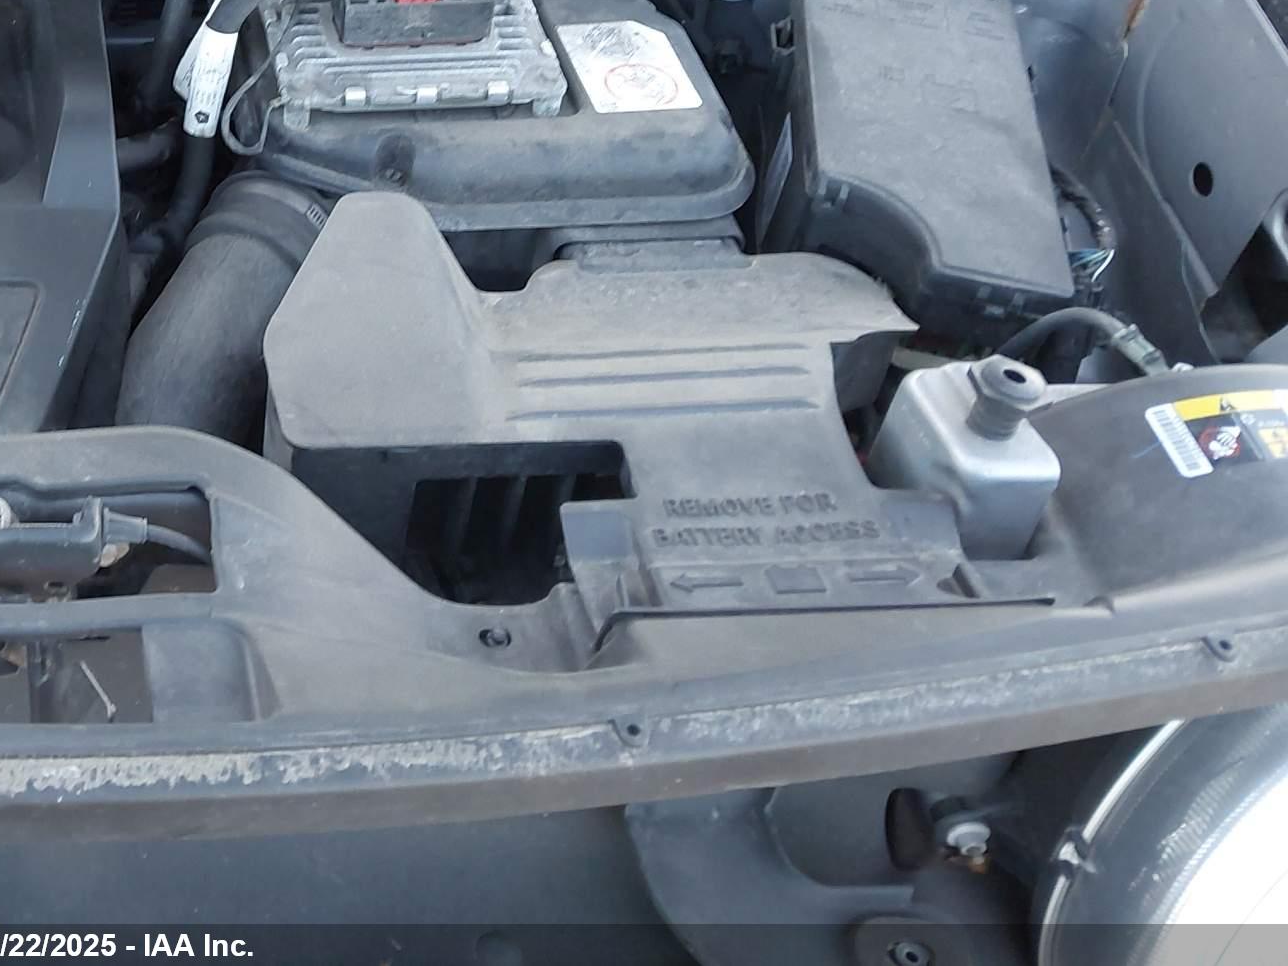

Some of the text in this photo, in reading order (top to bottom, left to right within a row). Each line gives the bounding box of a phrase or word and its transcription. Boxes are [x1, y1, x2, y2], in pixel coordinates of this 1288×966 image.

[662, 491, 838, 519] REMOVE FOR
[652, 519, 881, 548] BATTERY ACCESS
